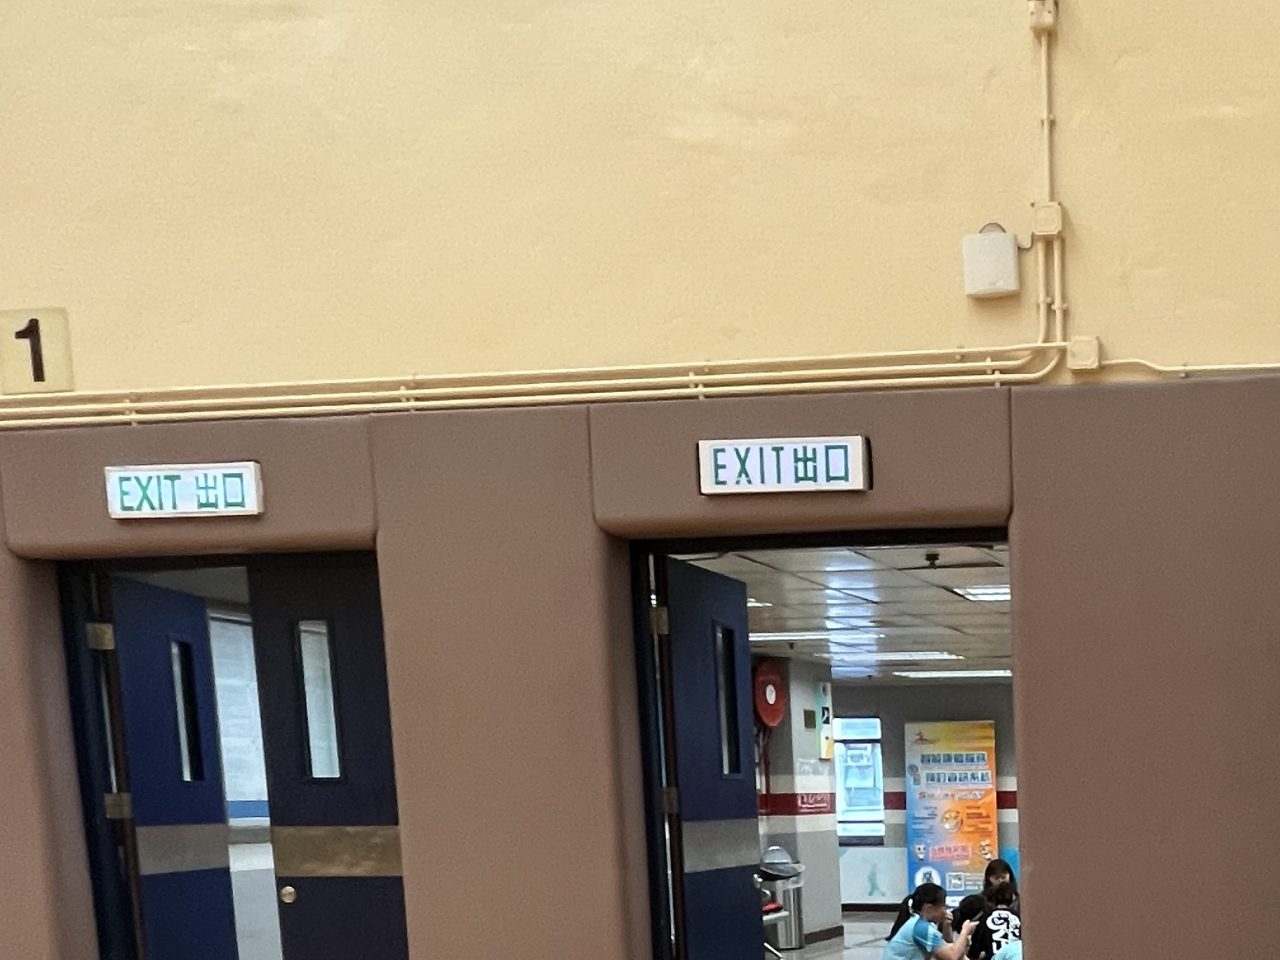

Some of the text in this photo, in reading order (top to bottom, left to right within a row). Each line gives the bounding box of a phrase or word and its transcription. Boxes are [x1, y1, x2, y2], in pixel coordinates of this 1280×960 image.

[15, 318, 45, 382] 1
[713, 445, 850, 486] EXIT 出口
[118, 472, 246, 512] EXIT 出口
